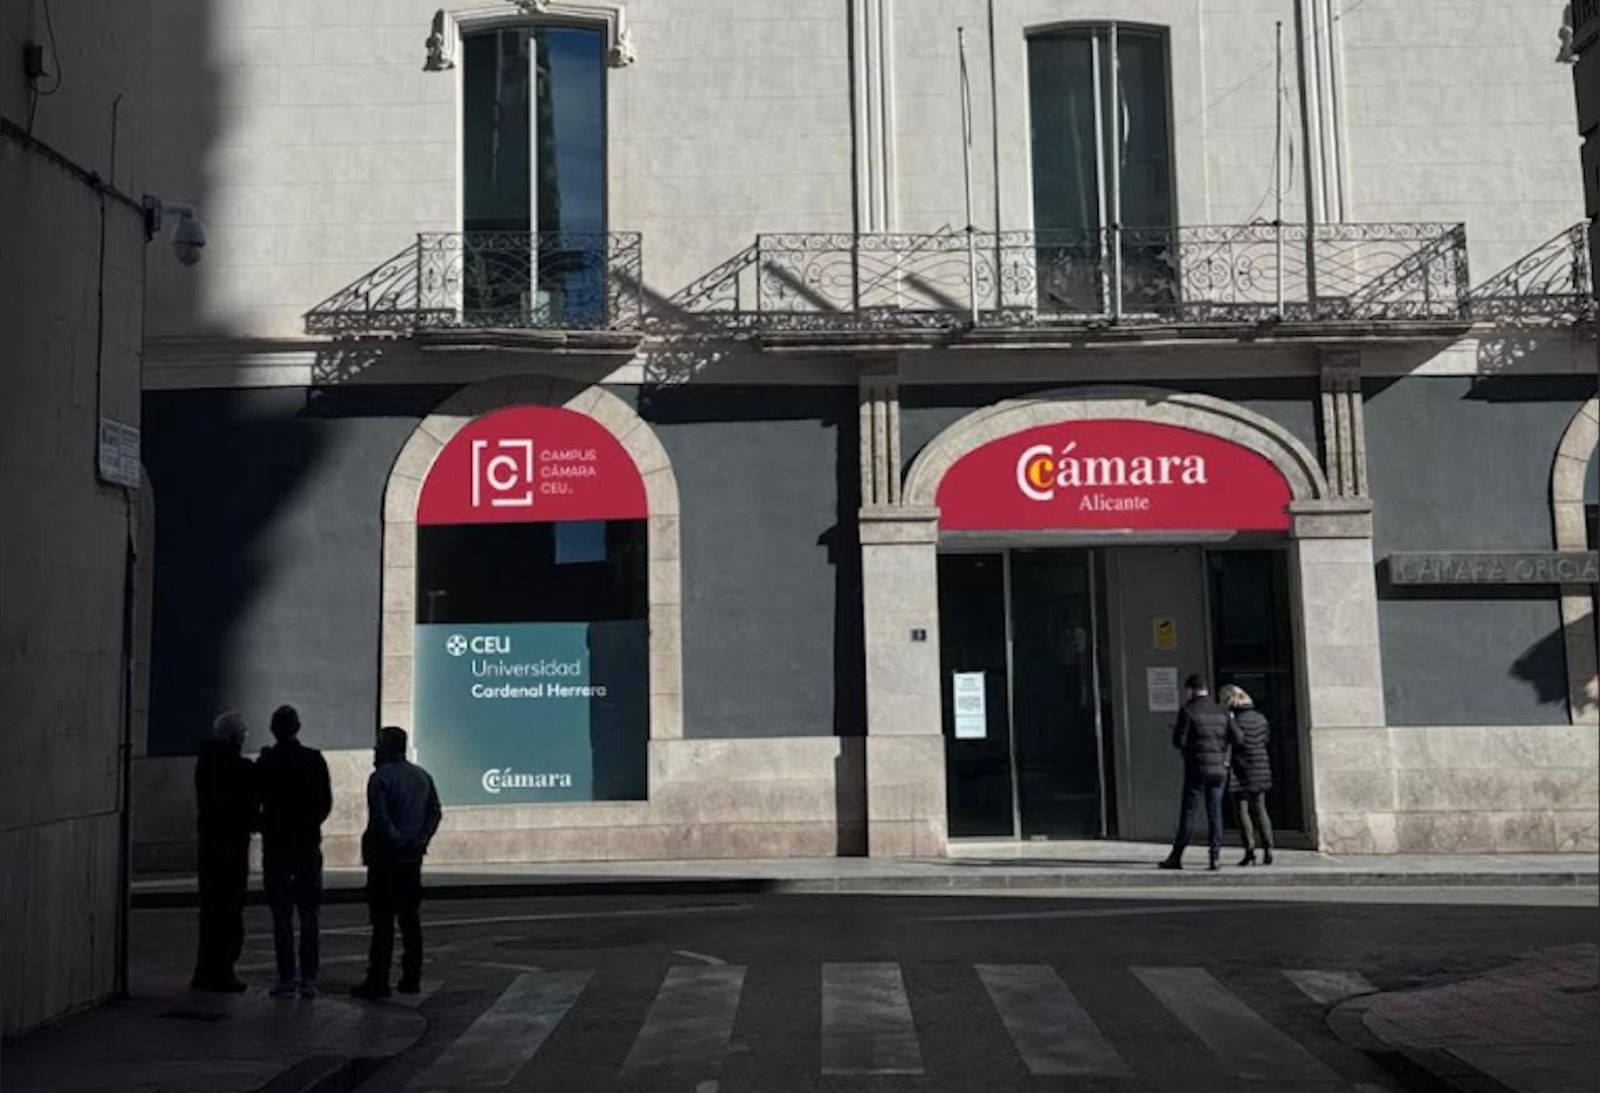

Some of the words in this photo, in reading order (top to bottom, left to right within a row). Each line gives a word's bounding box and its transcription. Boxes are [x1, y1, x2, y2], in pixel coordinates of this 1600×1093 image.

[540, 449, 597, 461] CAMPUS
[540, 464, 597, 478] CÁMARA
[1078, 494, 1150, 511] Alicante
[470, 636, 511, 654] CEU
[471, 659, 581, 677] Universidad
[471, 684, 543, 698] Cardenal
[547, 683, 607, 697] Herrera
